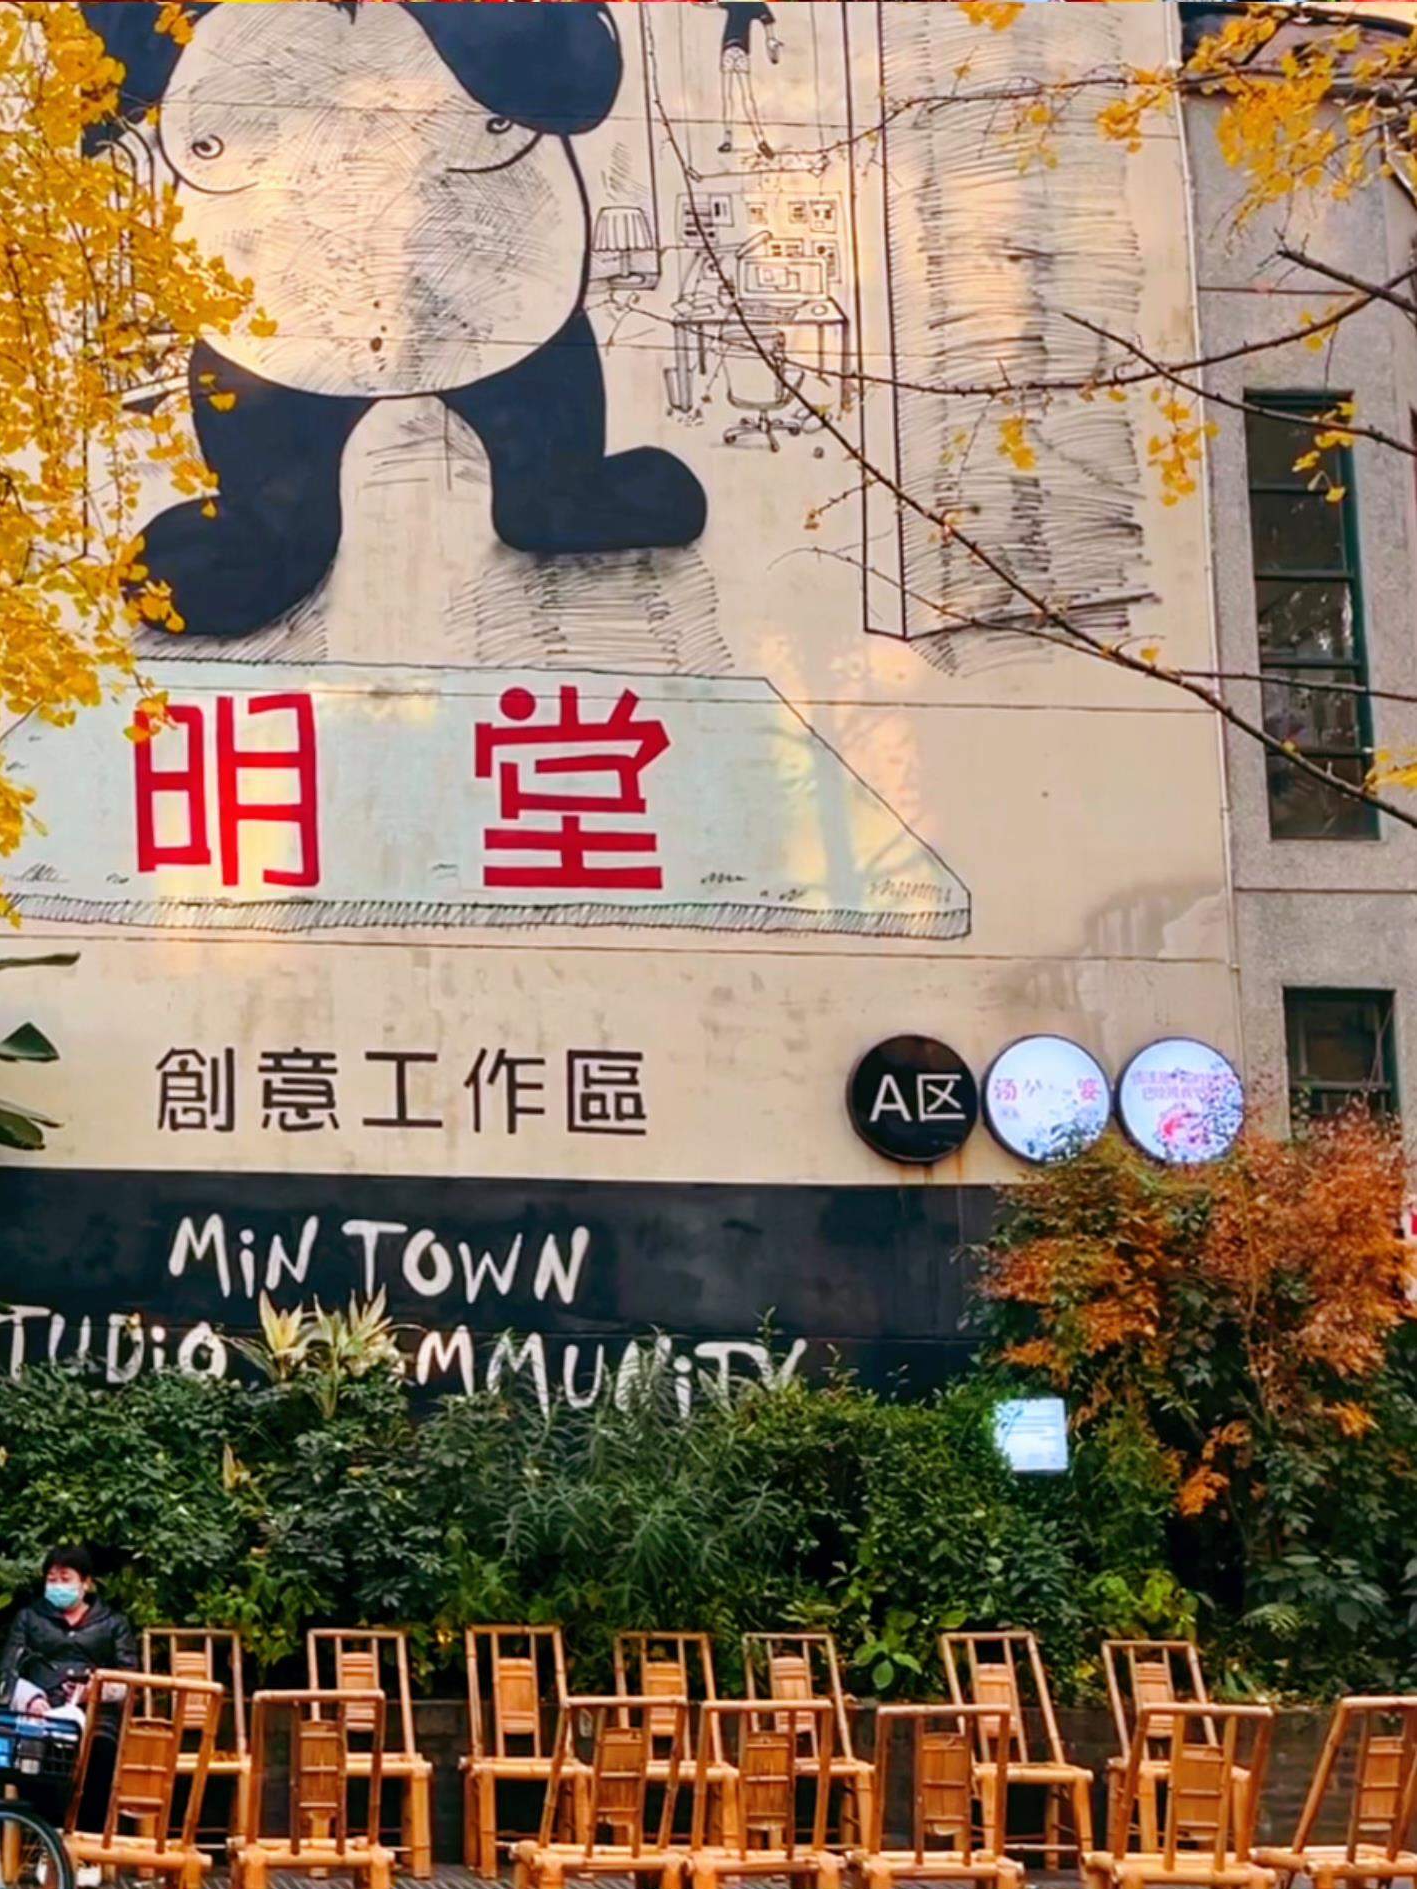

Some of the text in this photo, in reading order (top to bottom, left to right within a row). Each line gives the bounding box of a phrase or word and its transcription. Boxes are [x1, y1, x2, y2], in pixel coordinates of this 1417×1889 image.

[132, 685, 671, 889] 明堂
[155, 1046, 648, 1136] 創意工作區
[868, 1072, 966, 1125] A区
[342, 1219, 590, 1305] TOWN
